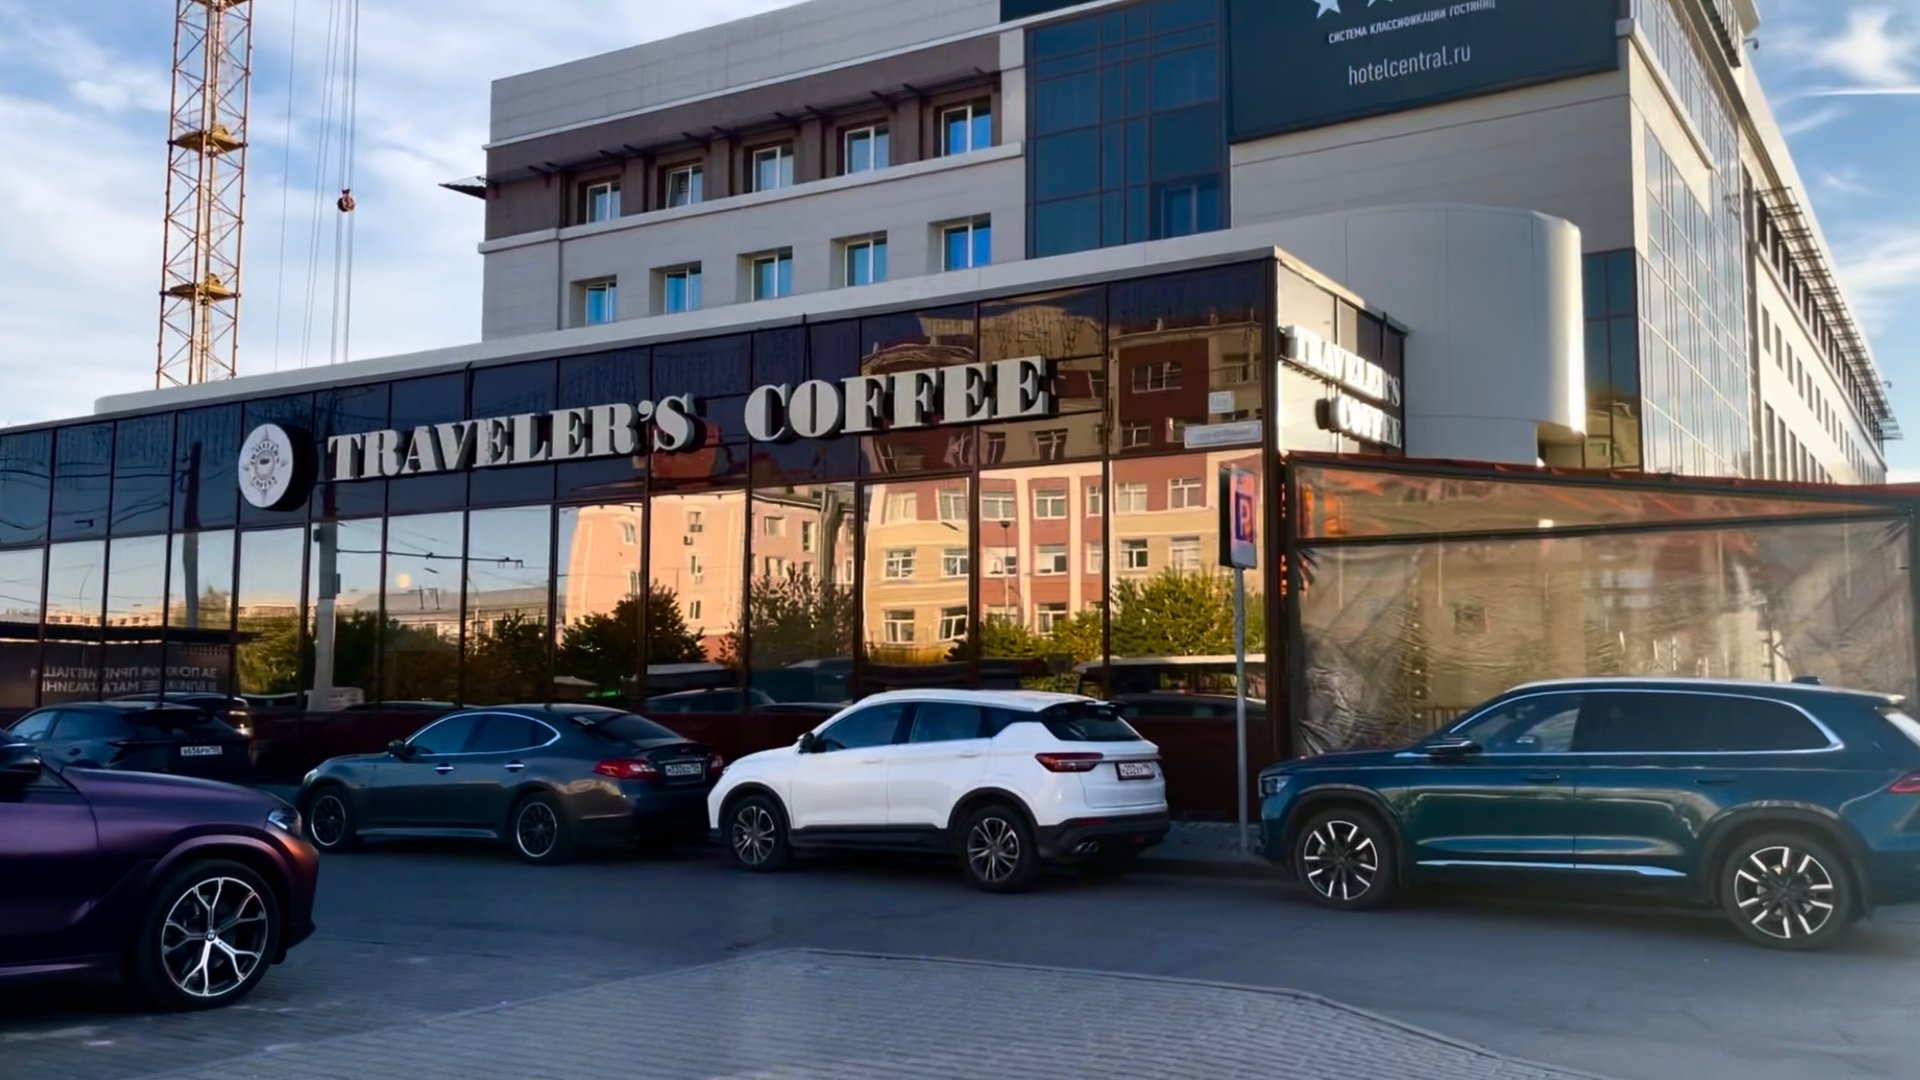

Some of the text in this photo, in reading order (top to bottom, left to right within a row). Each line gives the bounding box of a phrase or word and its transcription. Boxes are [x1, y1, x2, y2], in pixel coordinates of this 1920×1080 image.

[1328, 25, 1368, 44] СИСТЕМА
[1370, 8, 1447, 35] КЛАССИФИКАЦИИ
[1348, 45, 1472, 87] hotelcentral.ru
[327, 355, 1050, 482] TRAVELER'S COFFEE
